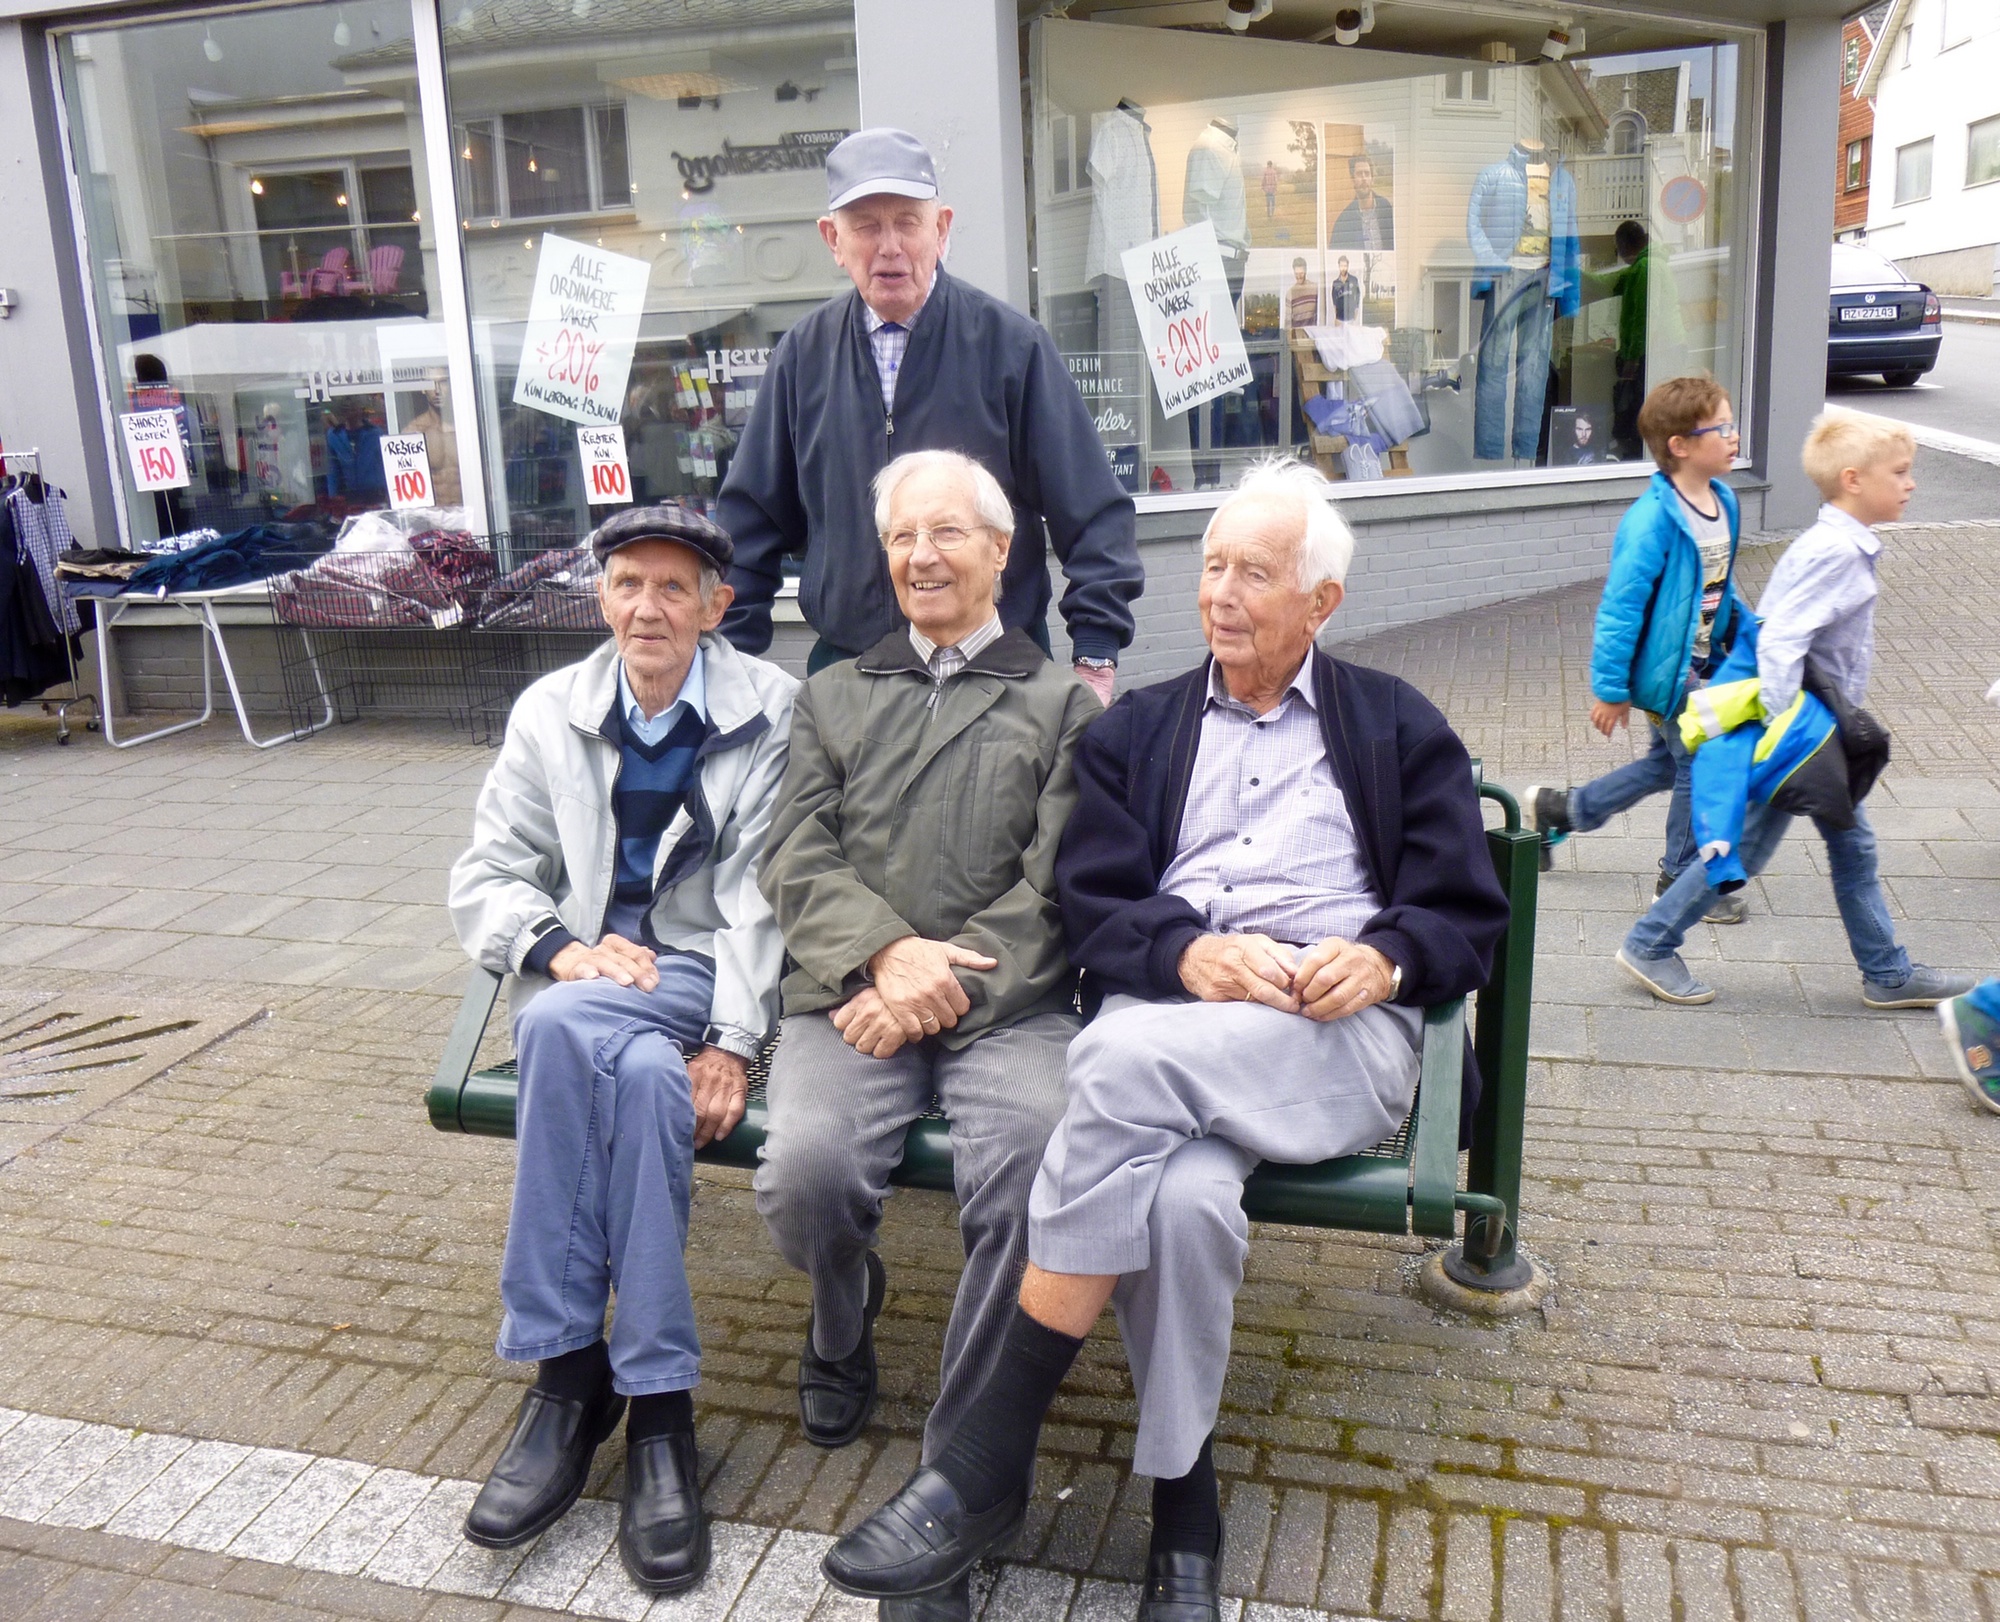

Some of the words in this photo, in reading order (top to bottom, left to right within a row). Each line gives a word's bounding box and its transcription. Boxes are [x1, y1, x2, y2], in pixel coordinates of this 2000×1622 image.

[569, 253, 606, 284] ALLE
[1151, 245, 1181, 277] ALLE
[1158, 290, 1194, 319] VARER
[1843, 309, 1858, 319] RZ
[560, 303, 599, 333] VARER
[706, 347, 775, 384] Herr
[1069, 358, 1101, 373] DENIM
[523, 378, 543, 400] KUN
[1074, 378, 1123, 394] ORMANCE
[1164, 390, 1182, 411] KUN
[128, 414, 168, 431] SHORTS
[384, 439, 425, 456] RESTER
[581, 430, 617, 446] RESTER
[138, 446, 176, 482] 150
[393, 470, 426, 502] 100
[592, 463, 626, 496] 100
